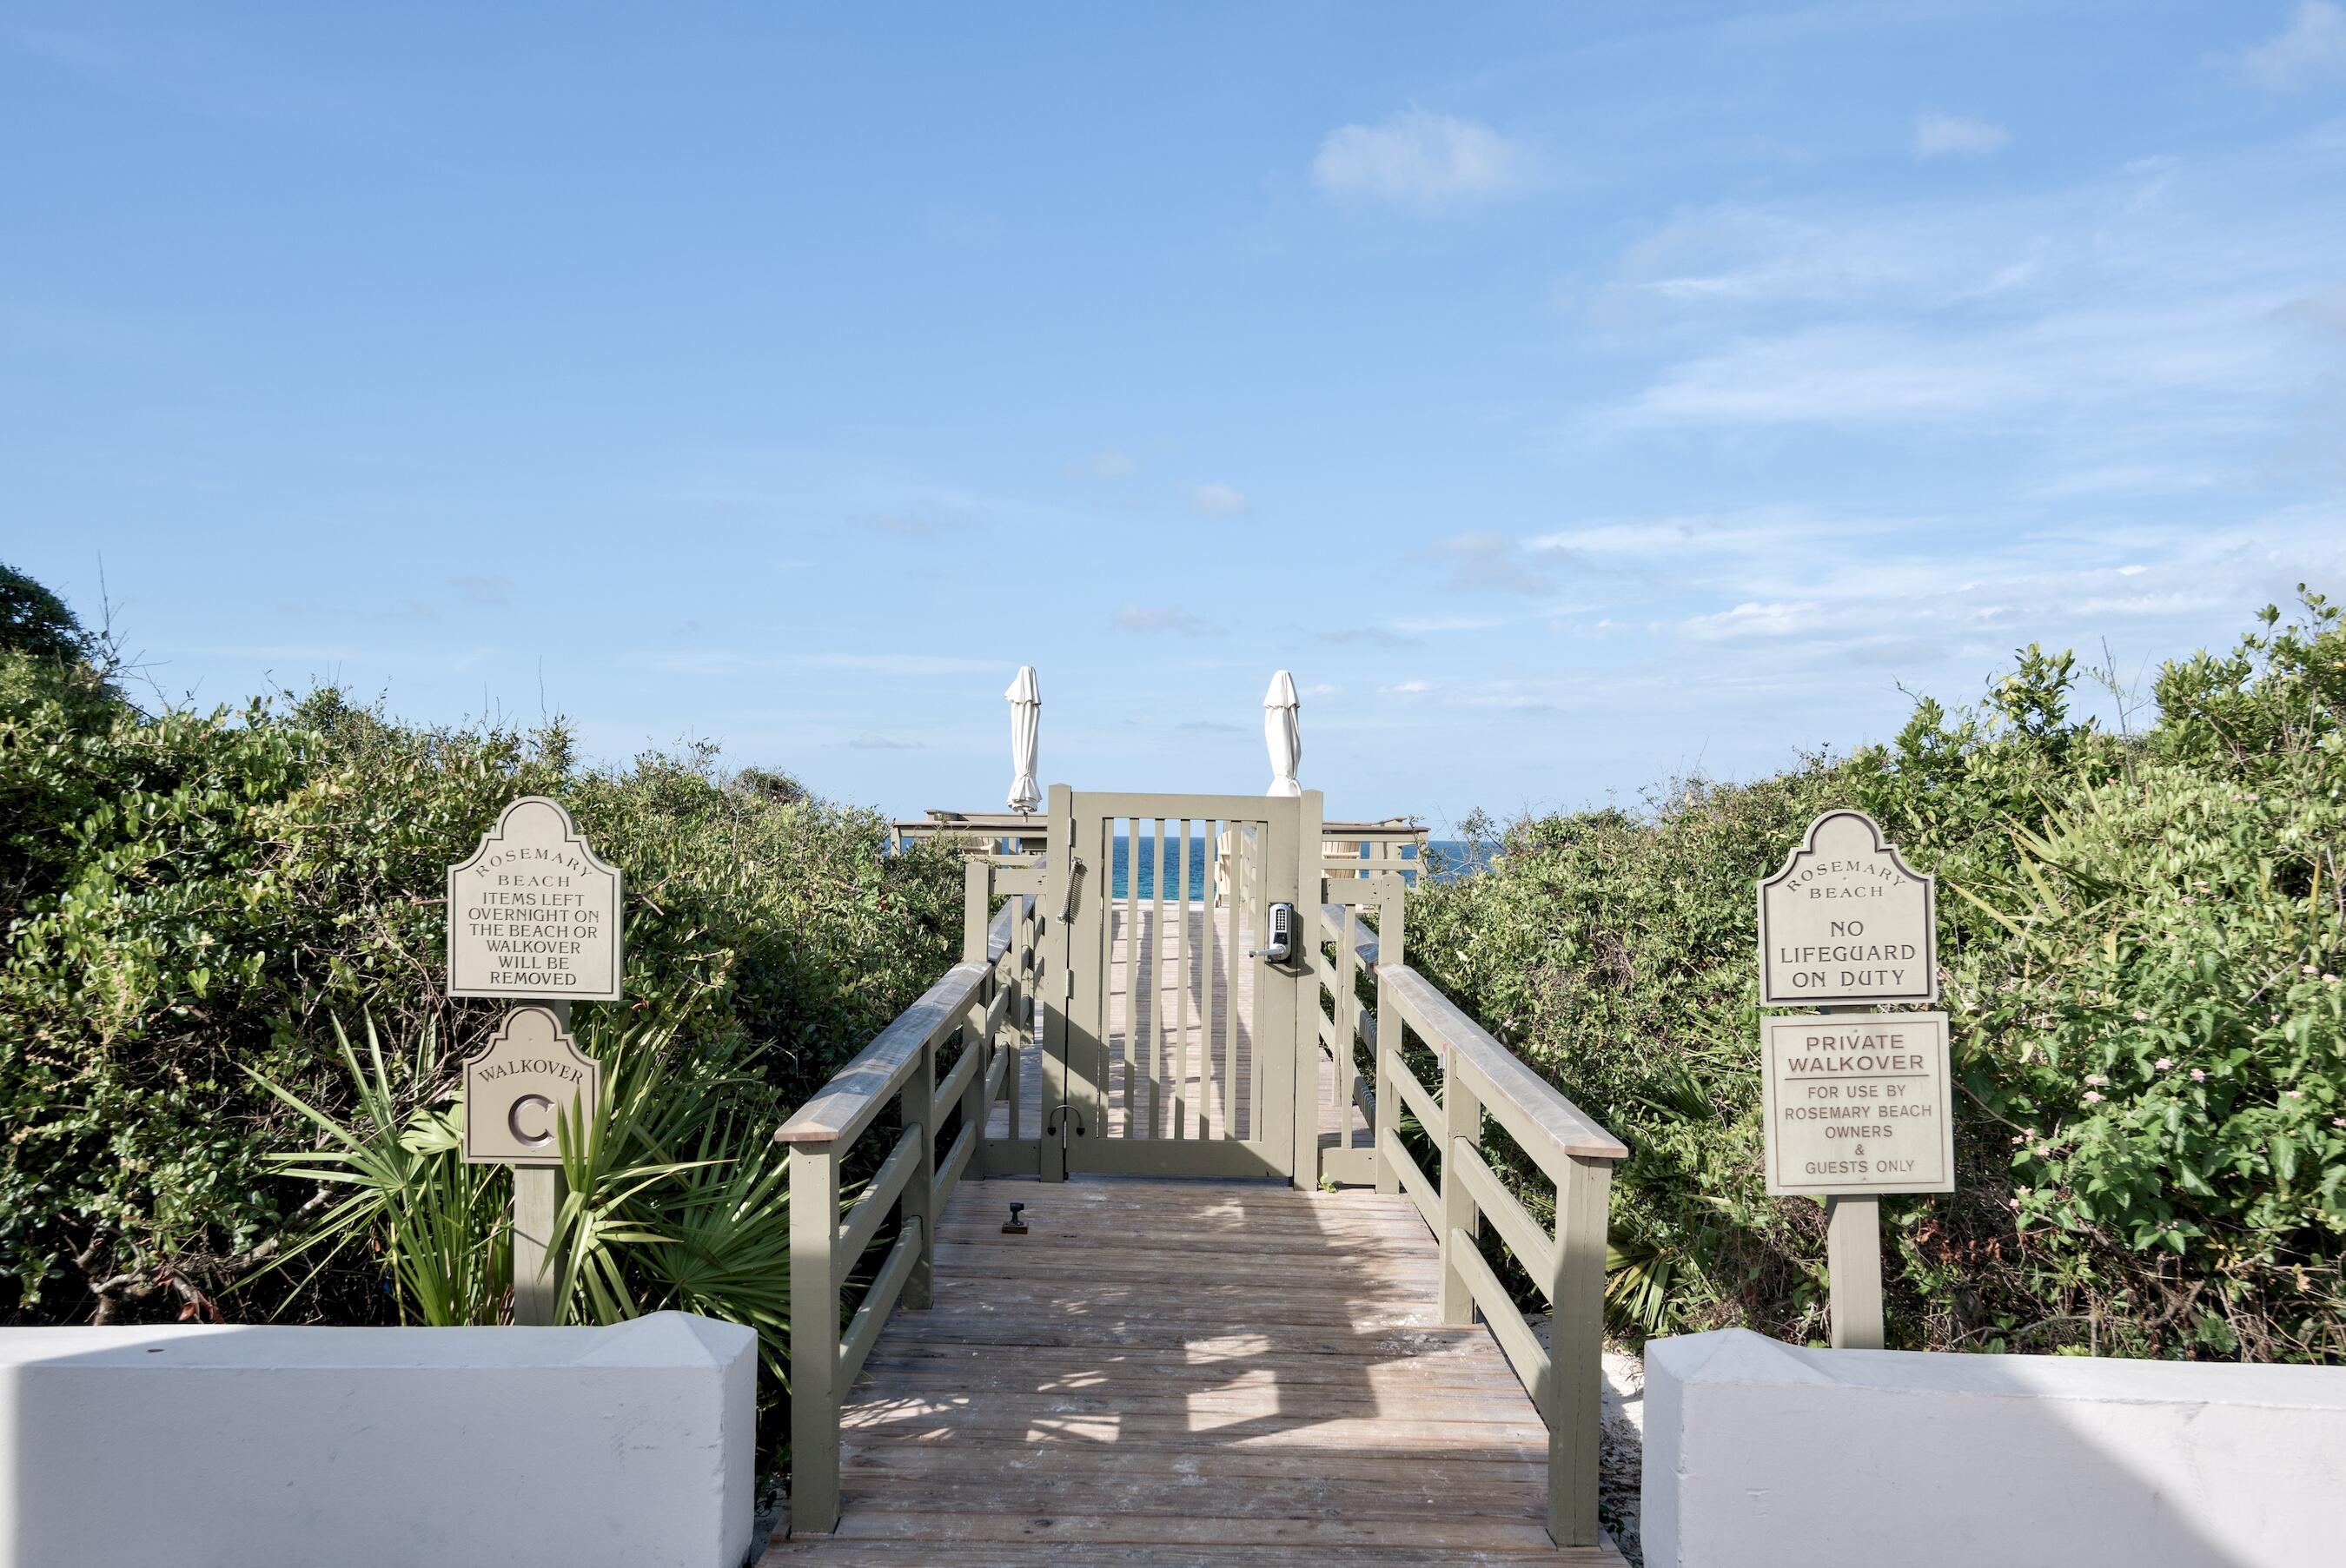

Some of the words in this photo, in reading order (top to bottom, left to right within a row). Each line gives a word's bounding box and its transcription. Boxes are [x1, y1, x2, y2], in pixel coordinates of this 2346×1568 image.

[475, 848, 593, 878] ROSEMARY
[499, 875, 570, 887] BEACH
[1786, 860, 1906, 893] ROSEMARY
[483, 892, 536, 906] ITEMS
[542, 893, 585, 906] LEFT
[1810, 886, 1883, 899] BEACH
[468, 908, 569, 923] OVERNIGHT
[574, 910, 599, 923] ON
[469, 923, 503, 936] THE
[509, 925, 567, 938] BEACH
[573, 926, 598, 938] OR
[1830, 921, 1864, 937] NO
[487, 940, 580, 954] WALKOVER
[1780, 944, 1915, 963] LIFEGUARD
[499, 956, 541, 969] WILL
[547, 956, 569, 969] BE
[490, 971, 577, 986] REMOVED
[1793, 971, 1826, 988] ON
[1841, 969, 1905, 987] DUTY
[1806, 1035, 1905, 1052] PRIVATE
[1788, 1055, 1924, 1072] WALKOVER
[479, 1059, 583, 1085] WALKOVER
[1808, 1086, 1839, 1099] FOR
[1846, 1085, 1879, 1098] USE
[1886, 1084, 1906, 1097] BY
[1785, 1106, 1870, 1120] ROSEMARY
[1879, 1104, 1932, 1118] BEACH
[507, 1093, 555, 1148] C
[1825, 1125, 1893, 1139] OWNERS
[1854, 1143, 1865, 1155] &
[1806, 1161, 1868, 1174] GUESTS
[1876, 1160, 1915, 1173] ONLY
